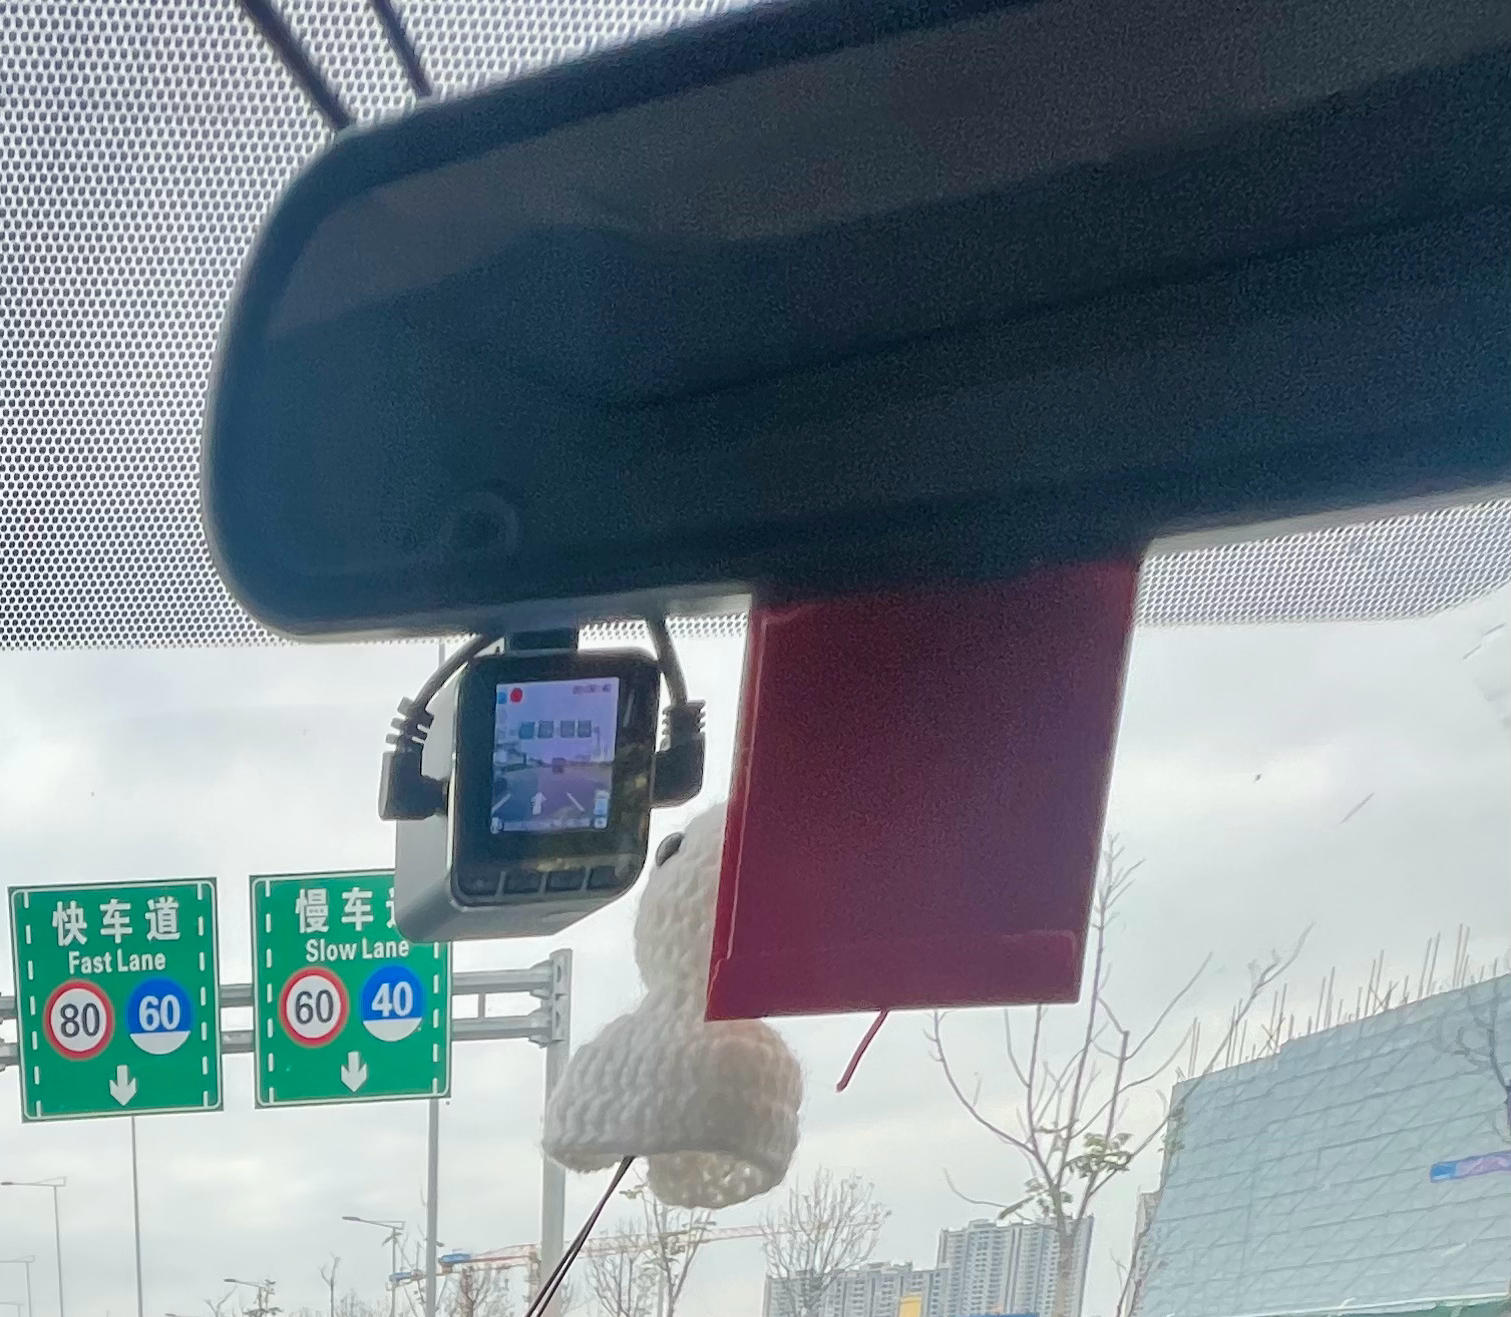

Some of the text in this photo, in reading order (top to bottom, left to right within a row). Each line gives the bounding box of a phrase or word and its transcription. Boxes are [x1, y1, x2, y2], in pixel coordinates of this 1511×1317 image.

[52, 895, 181, 947] 快车道
[68, 949, 165, 975] Fast Lane
[305, 937, 410, 962] Slow Lane
[138, 995, 180, 1031] 60
[295, 989, 334, 1025] 60
[371, 981, 413, 1018] 40
[60, 1003, 101, 1039] 80
